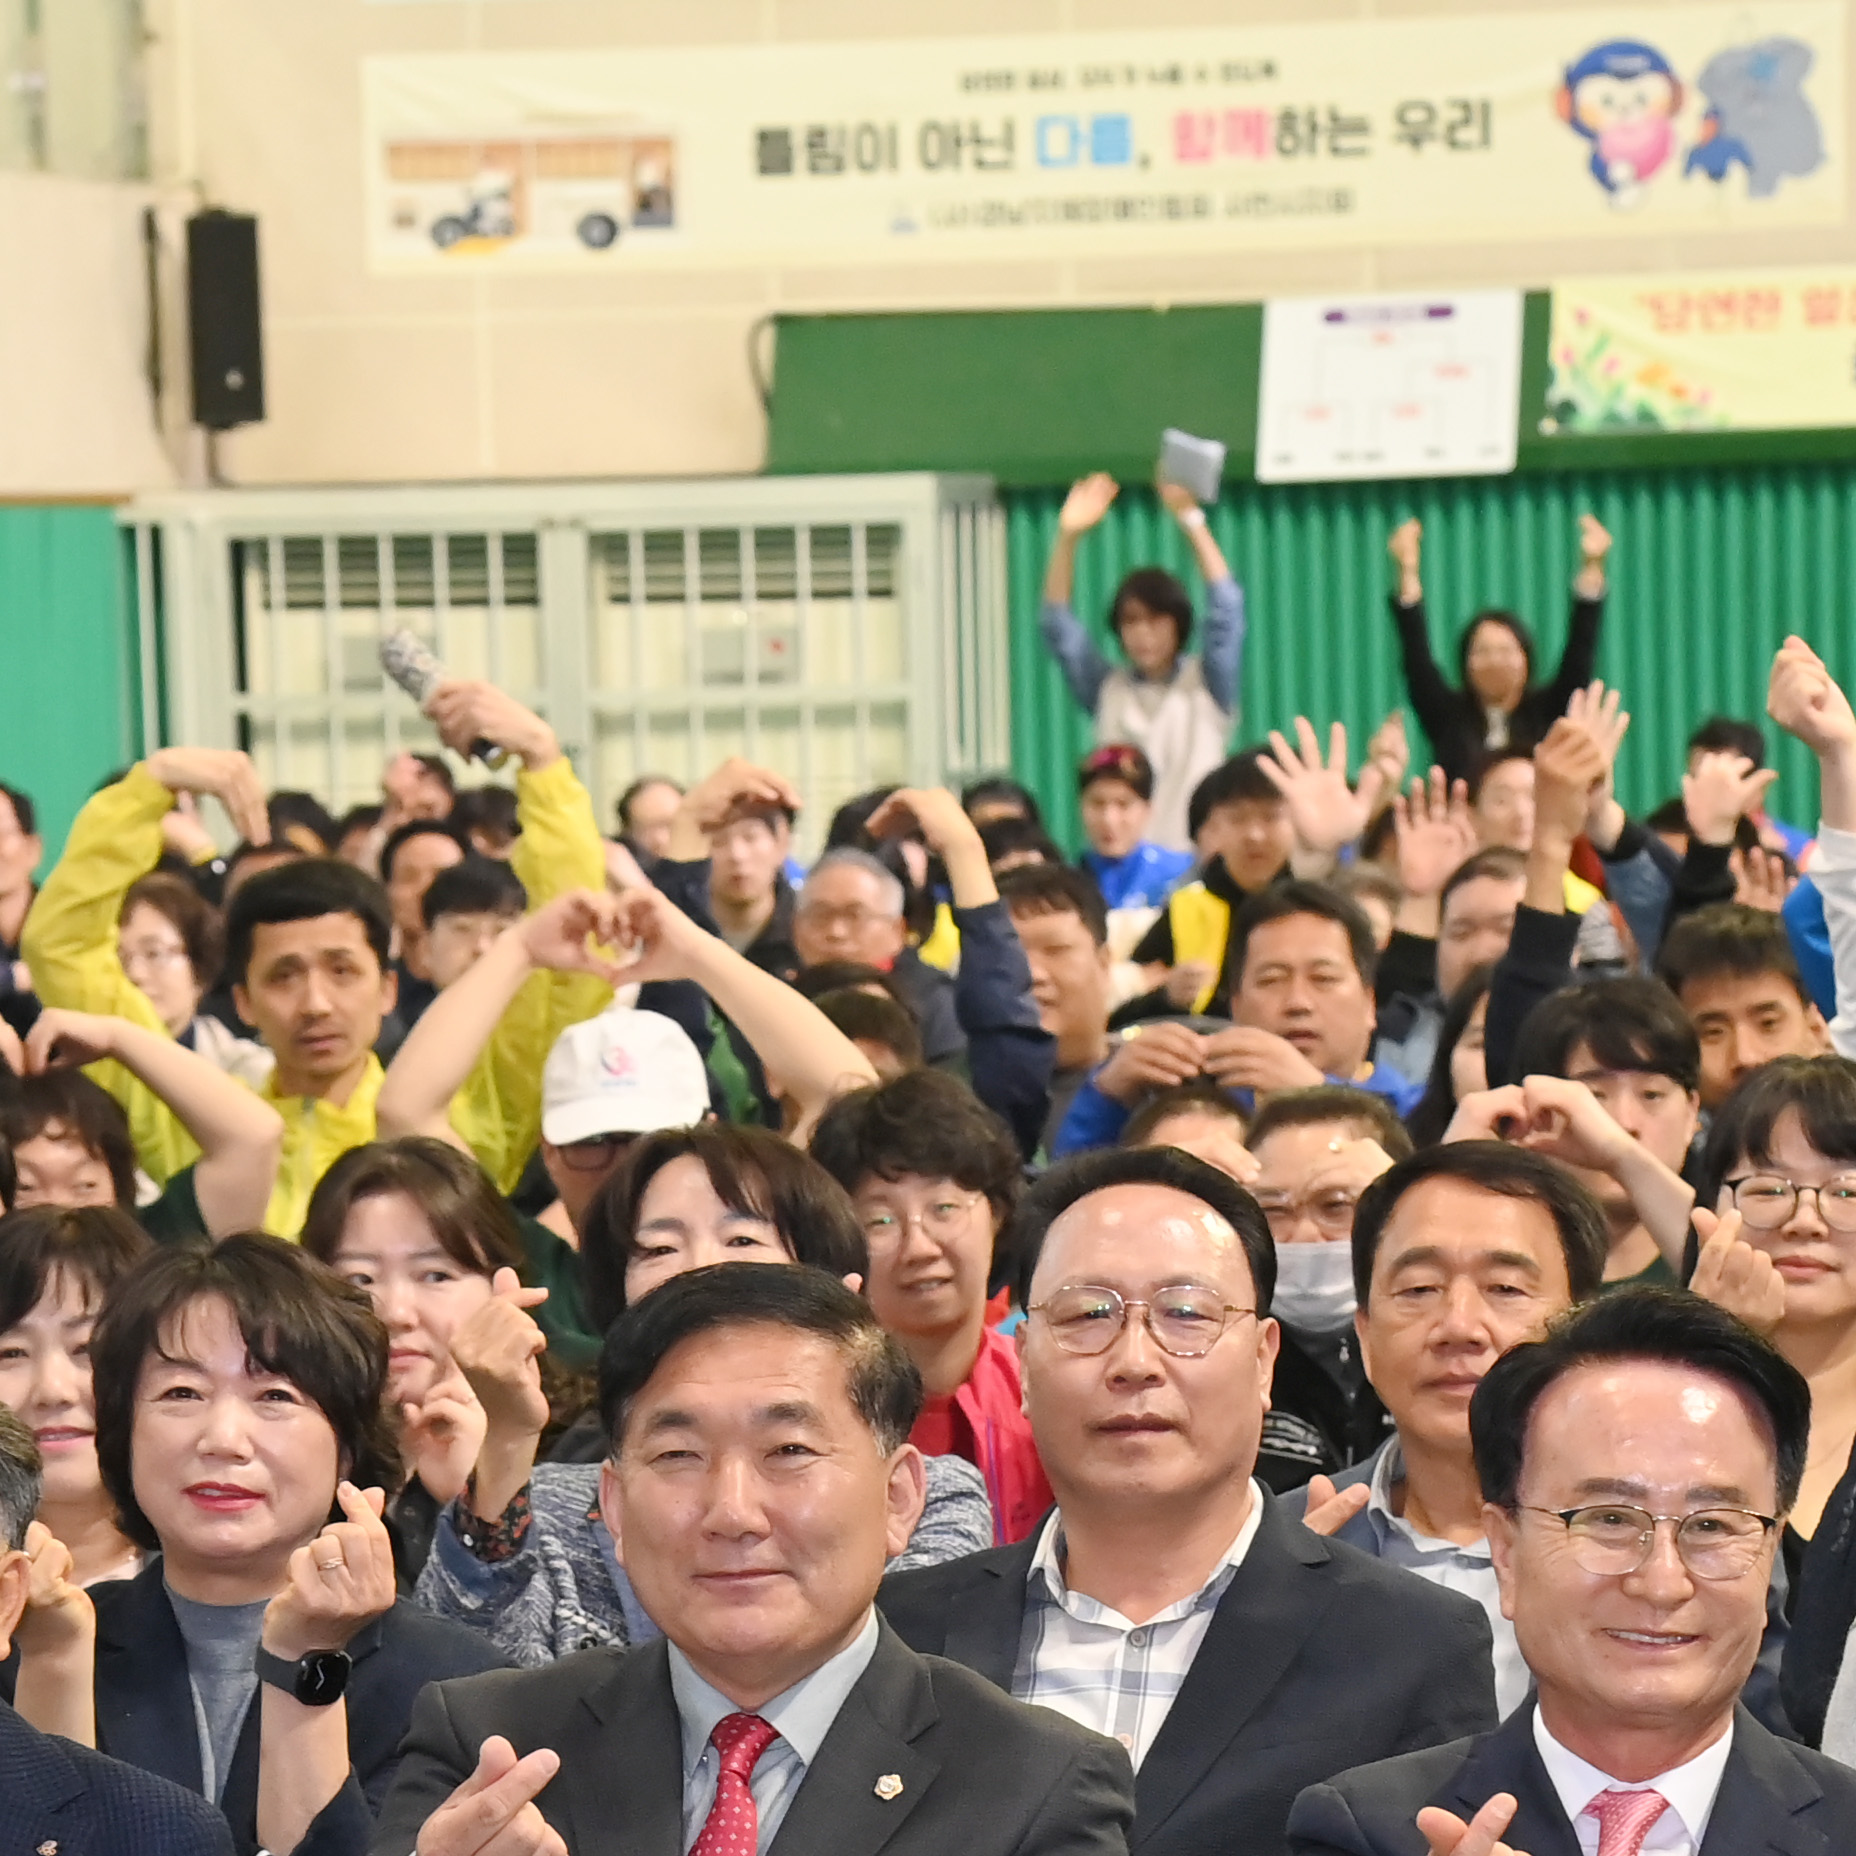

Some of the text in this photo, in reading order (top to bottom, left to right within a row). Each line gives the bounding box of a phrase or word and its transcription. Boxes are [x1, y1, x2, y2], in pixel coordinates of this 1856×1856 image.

[755, 120, 898, 176] 틀림이
[918, 115, 1014, 171] 아닌
[1173, 106, 1371, 163] 함께하는
[1393, 98, 1492, 151] 우리
